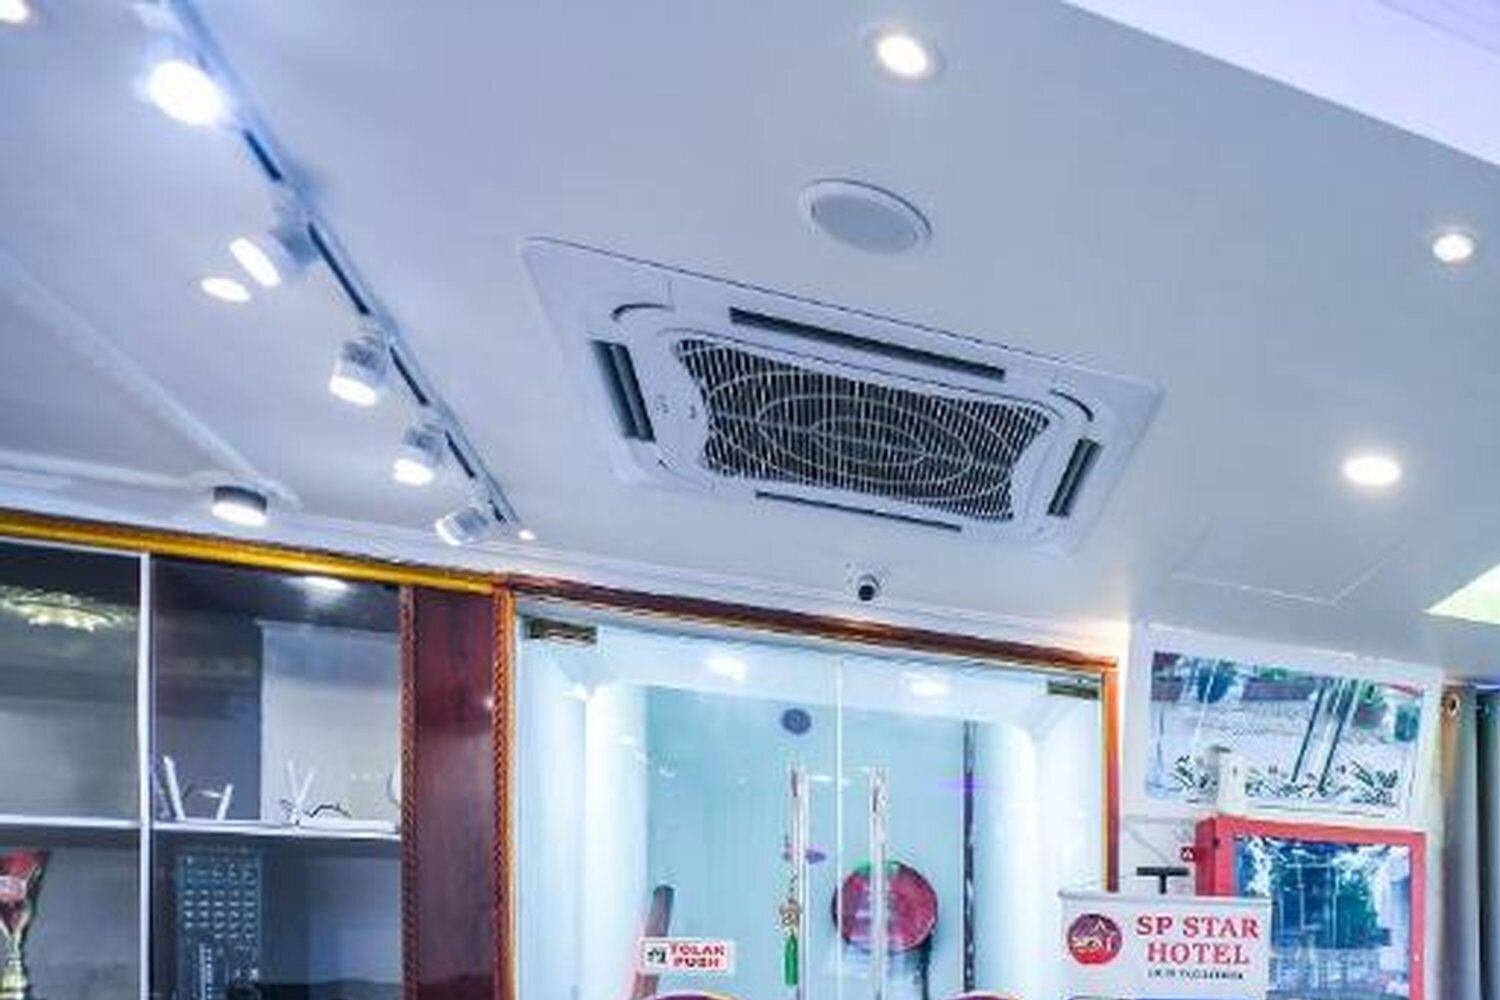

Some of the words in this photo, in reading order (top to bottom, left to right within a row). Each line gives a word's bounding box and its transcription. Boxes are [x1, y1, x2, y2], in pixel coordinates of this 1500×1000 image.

[1136, 915, 1173, 936] SP
[1182, 916, 1260, 938] STAR
[669, 943, 725, 956] TOLAK
[1147, 943, 1250, 965] HOTEL
[672, 956, 720, 968] PUSH
